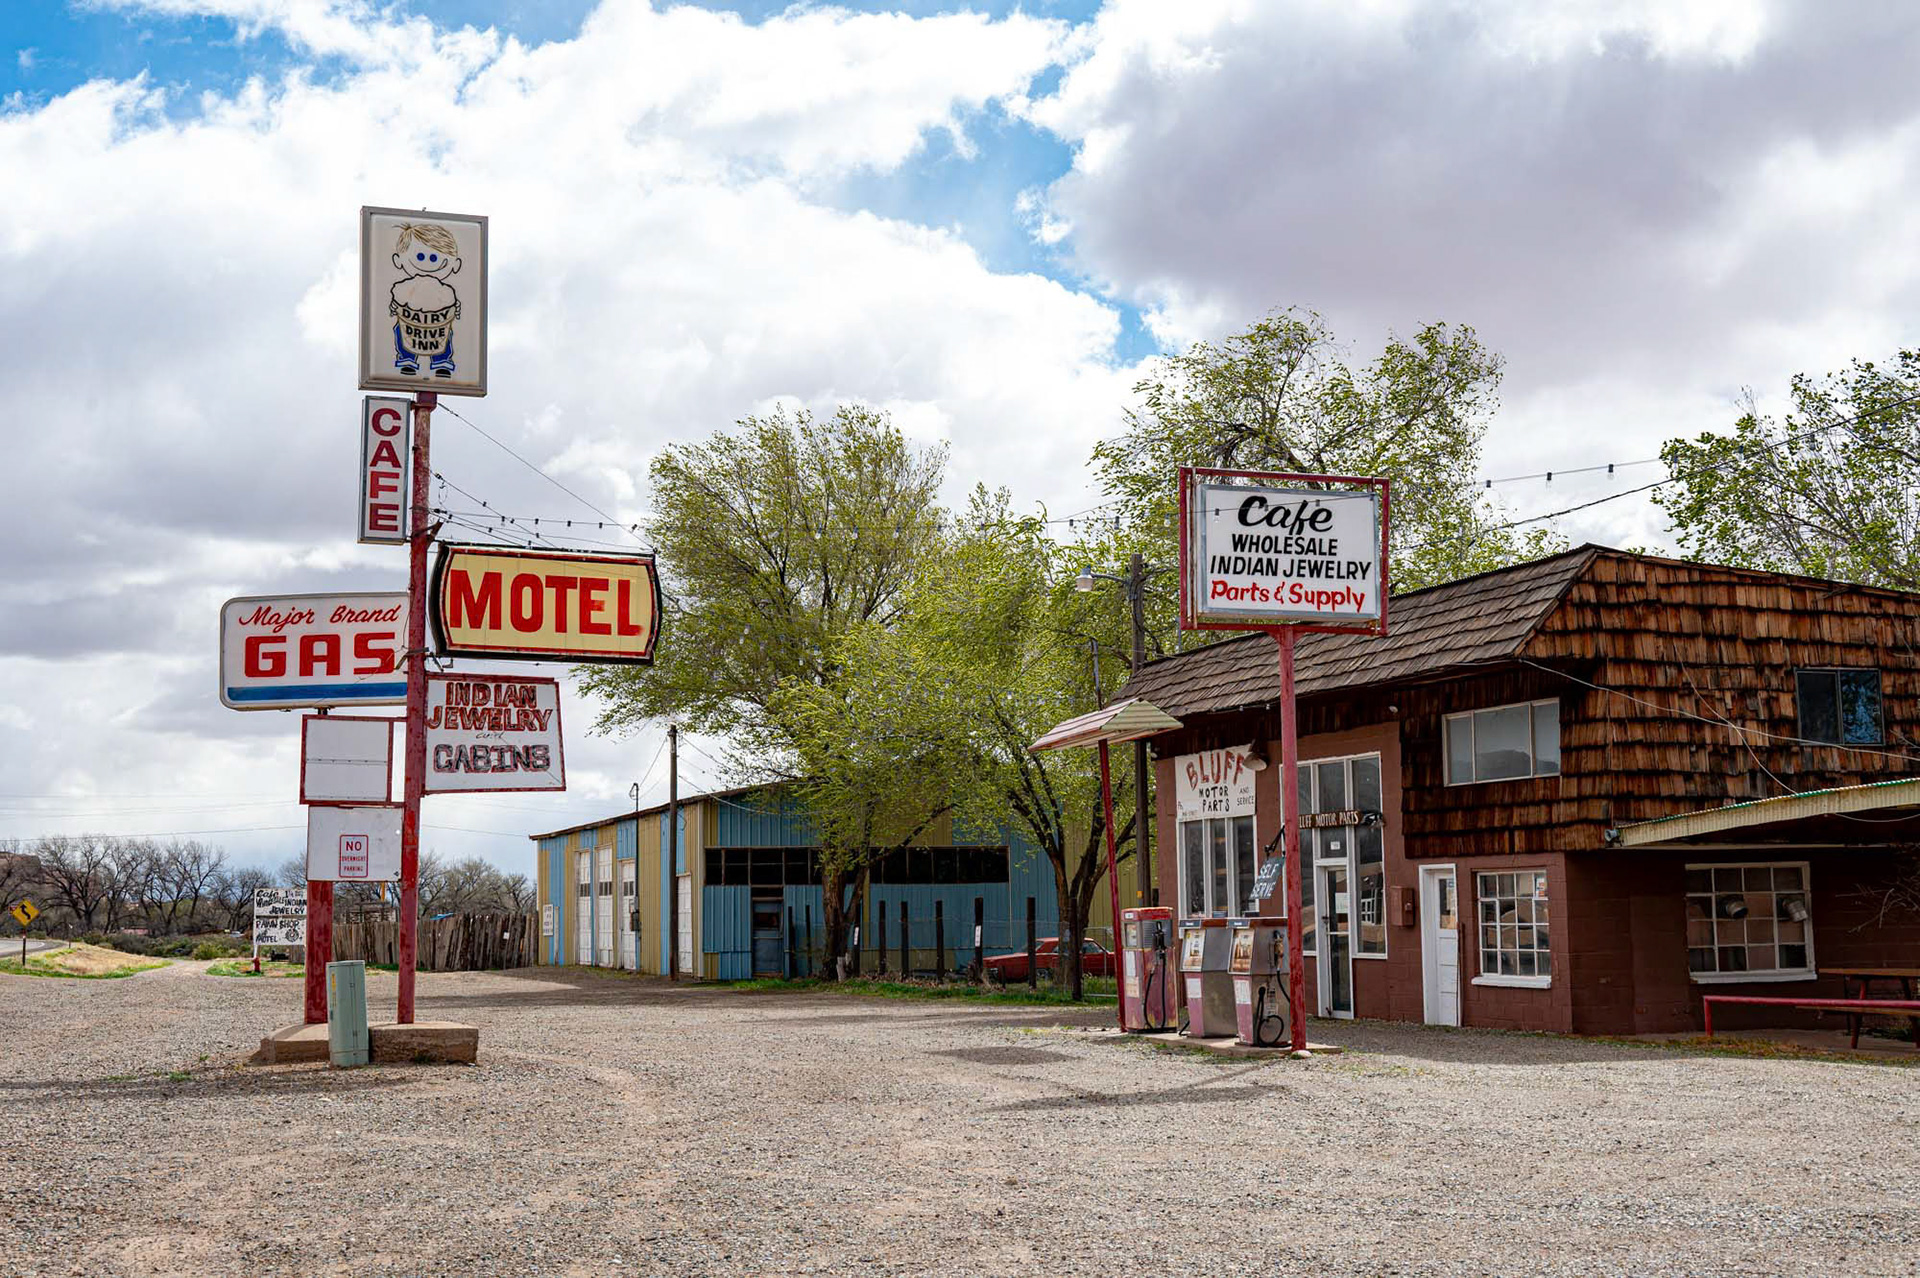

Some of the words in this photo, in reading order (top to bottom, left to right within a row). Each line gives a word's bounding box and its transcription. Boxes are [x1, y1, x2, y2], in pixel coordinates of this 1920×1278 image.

[402, 308, 450, 324] DAIRY
[405, 325, 446, 339] DRIVE
[411, 339, 439, 351] INN
[369, 407, 402, 532] CAFE
[1238, 495, 1333, 535] Cafe
[1232, 533, 1338, 556] WHOLESALE
[1210, 555, 1279, 577] INDIAN
[1283, 558, 1372, 580] JEWELRY
[450, 569, 645, 636] MOTEL
[1210, 579, 1270, 602] Parts
[1289, 582, 1365, 613] Supply
[239, 605, 315, 633] Major
[330, 604, 401, 624] Brand
[244, 632, 395, 678] GAS
[445, 682, 538, 709] INDIAN
[425, 705, 553, 732] JEWELRY
[433, 744, 551, 773] CABINS
[1186, 751, 1244, 791] BLUFF
[1199, 786, 1229, 798] MOTOR
[1237, 796, 1254, 806] SERVICE
[1202, 799, 1230, 812] PARTS
[1315, 812, 1337, 827] MOTOR
[1339, 810, 1359, 825] PARTS
[345, 840, 362, 851] NO
[1258, 862, 1279, 879] SELF
[269, 905, 305, 915] JEWELRY
